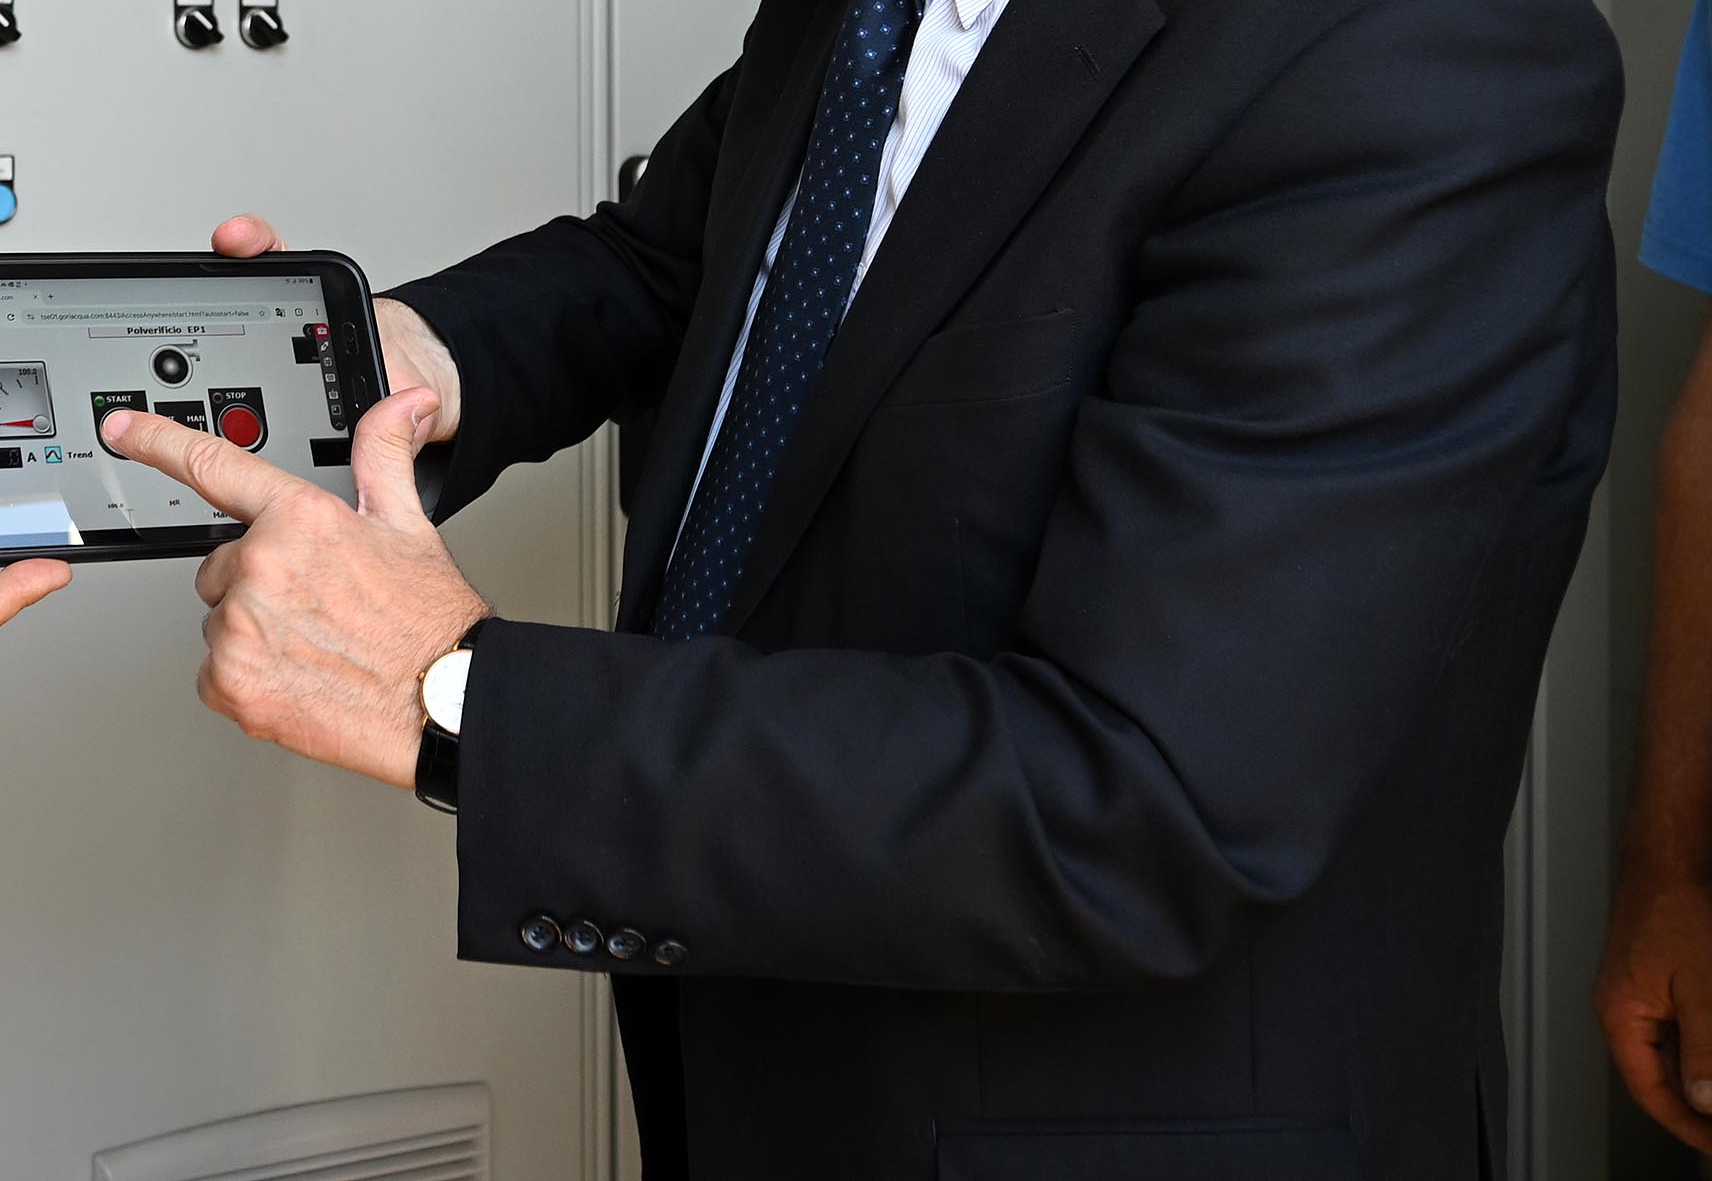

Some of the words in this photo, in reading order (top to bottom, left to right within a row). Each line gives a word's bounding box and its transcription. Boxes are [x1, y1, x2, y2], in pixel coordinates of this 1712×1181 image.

[127, 326, 182, 336] Polverificio
[188, 325, 206, 334] EP1
[18, 368, 37, 376] 100.0
[106, 395, 132, 404] START
[225, 392, 247, 400] STOP
[27, 452, 37, 463] A
[67, 451, 93, 459] Trend
